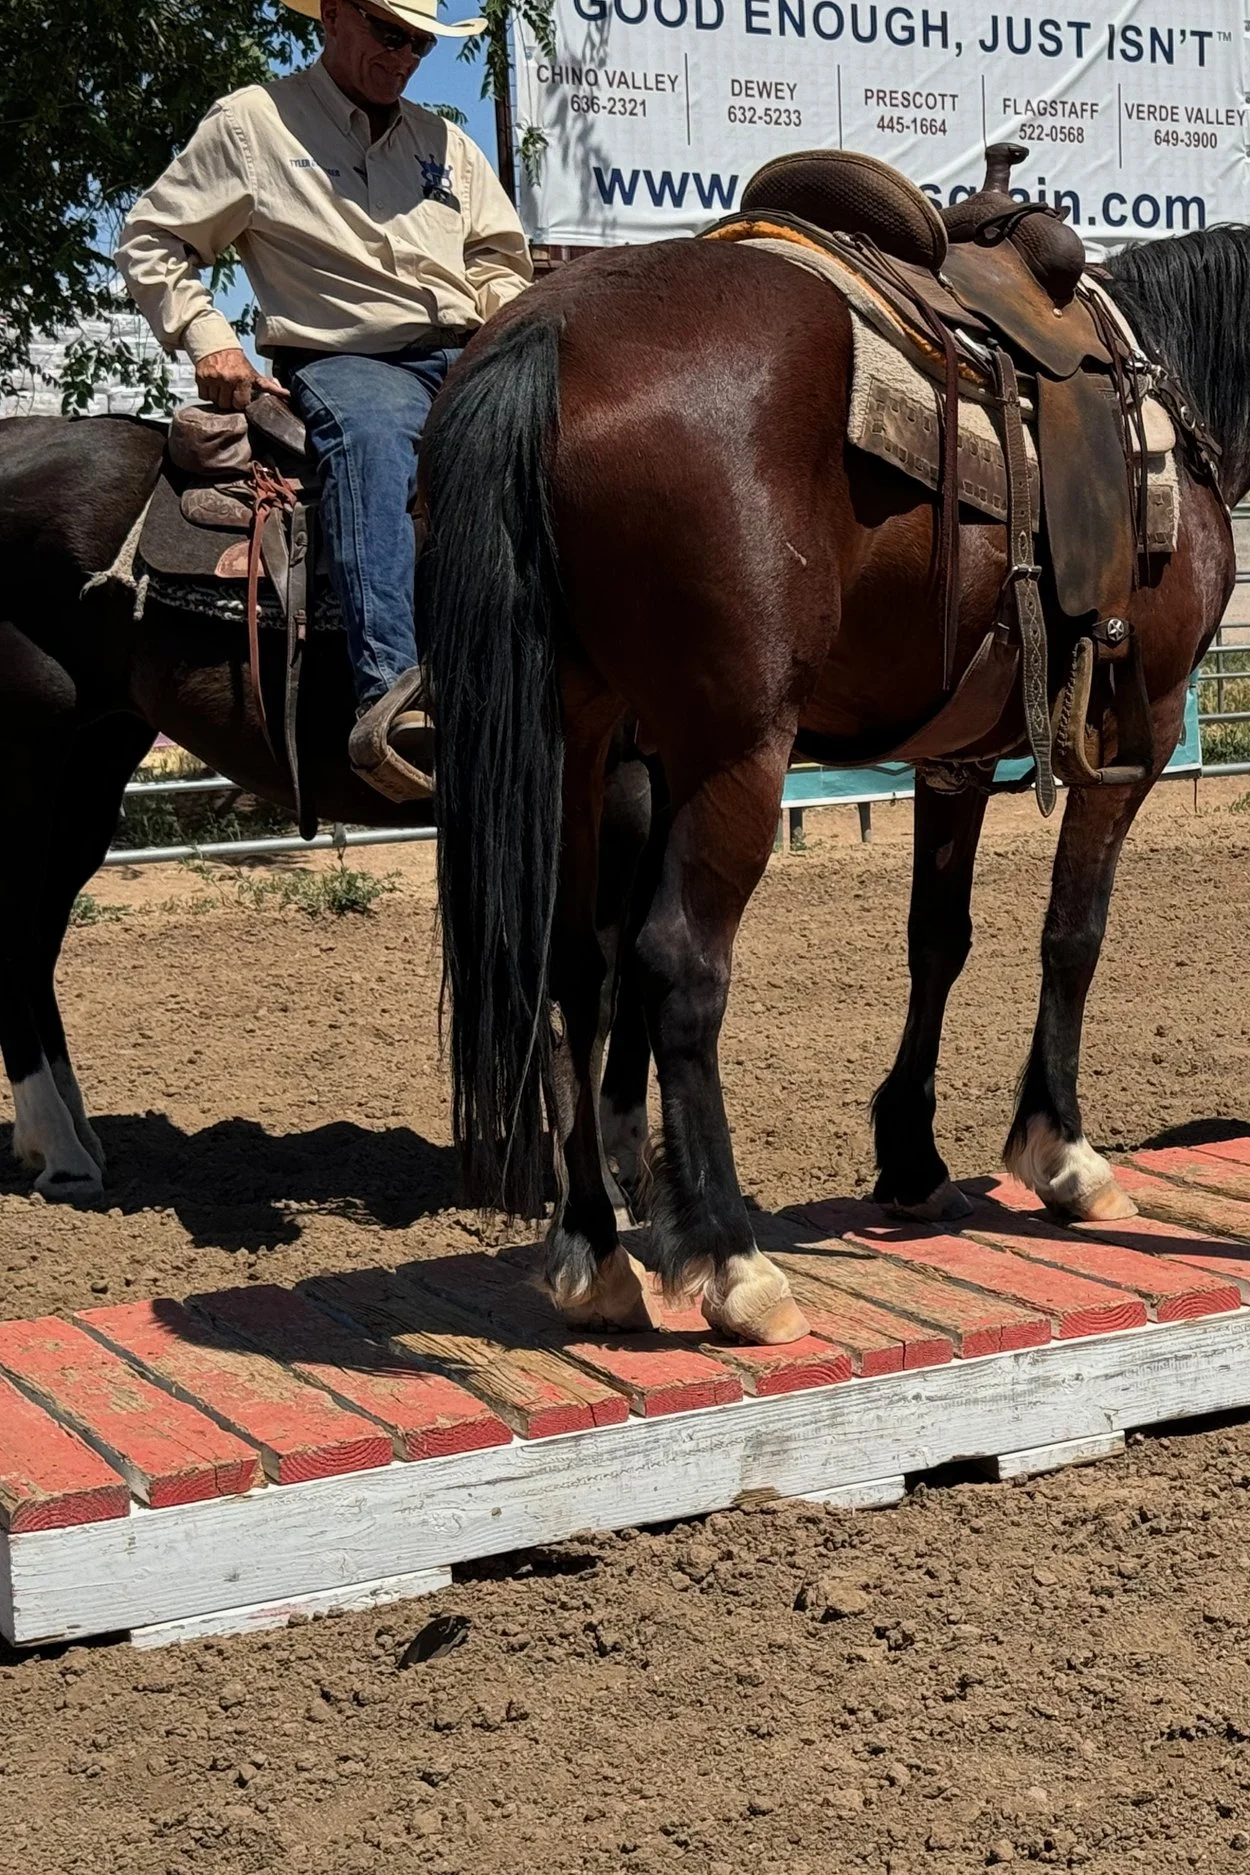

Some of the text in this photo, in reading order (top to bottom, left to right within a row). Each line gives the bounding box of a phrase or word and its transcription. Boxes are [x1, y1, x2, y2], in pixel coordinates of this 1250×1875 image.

[573, 0, 724, 31] GOOD
[744, 0, 962, 58] ENOUGH,
[978, 15, 1092, 58] JUST
[536, 64, 680, 93] CHINO VALLEY
[730, 78, 798, 101] DEWEY
[570, 94, 647, 117] 636-2321
[864, 87, 959, 112] PRESCOTT
[1002, 98, 1100, 120] FLAGSTAFF
[727, 104, 802, 127] 632-5233
[876, 115, 948, 137] 445-1664
[1124, 103, 1245, 126] VERDE VALLEY
[1018, 125, 1085, 144] 522-0568
[1153, 129, 1218, 149] 649-3900
